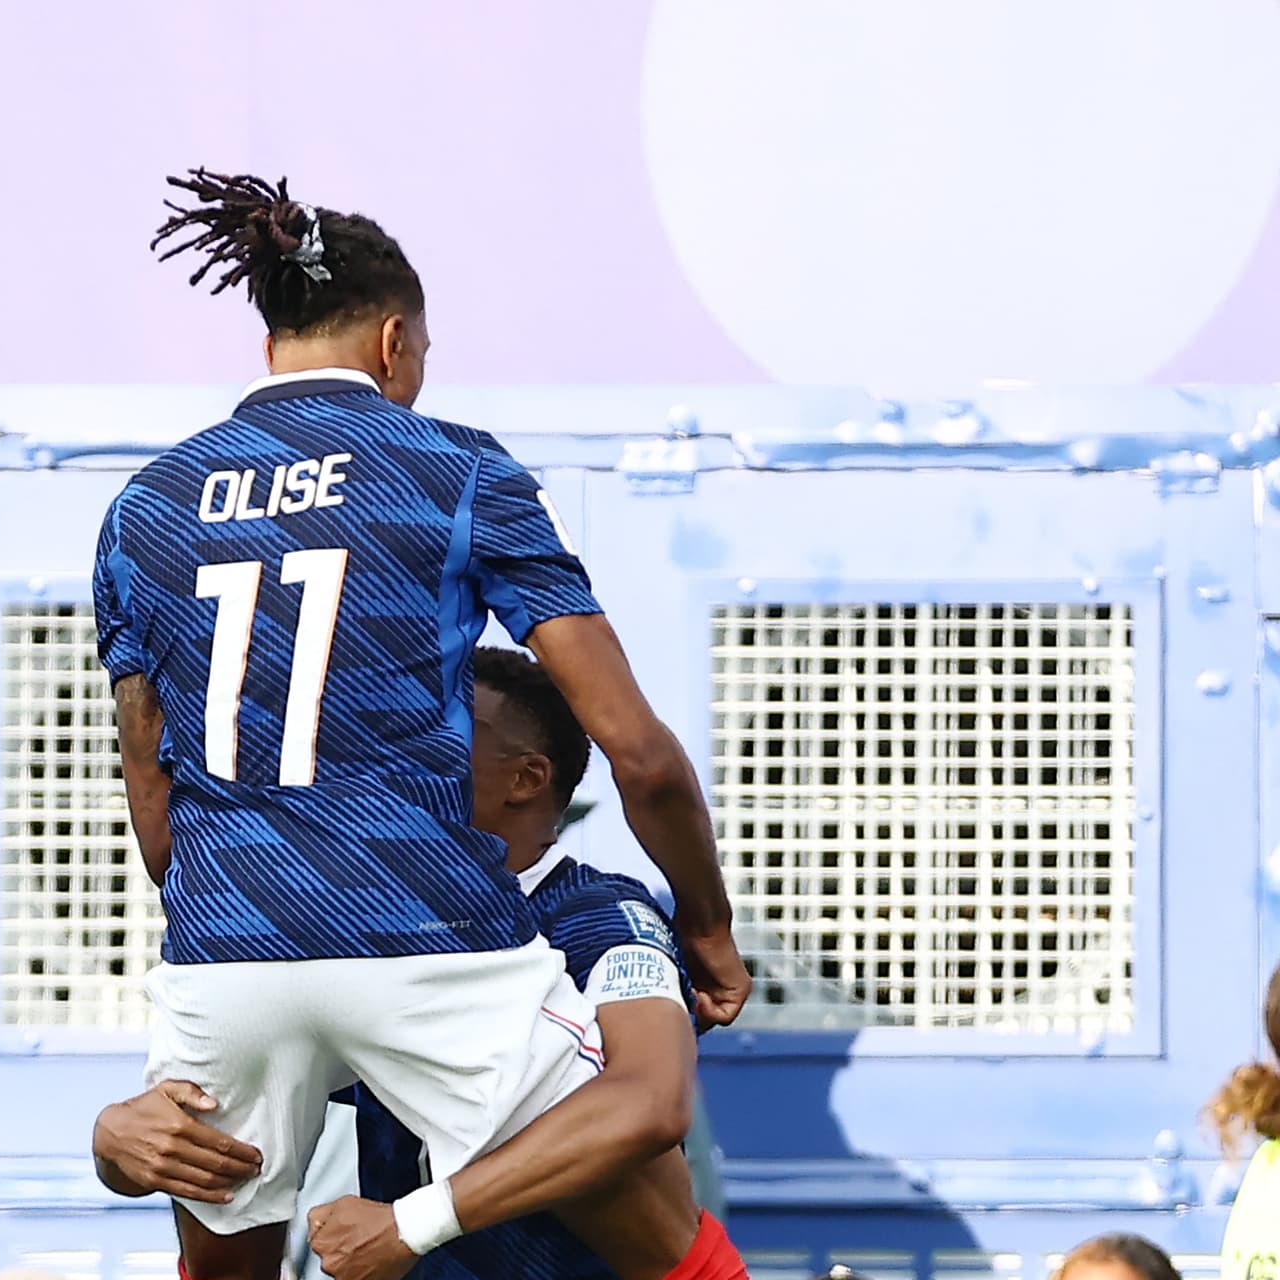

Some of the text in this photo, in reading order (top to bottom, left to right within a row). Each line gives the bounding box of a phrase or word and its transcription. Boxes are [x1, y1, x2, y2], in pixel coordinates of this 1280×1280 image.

[198, 453, 352, 523] OLISE
[195, 548, 349, 786] 11
[605, 962, 665, 982] UNITES
[606, 951, 665, 967] FOOTBALL
